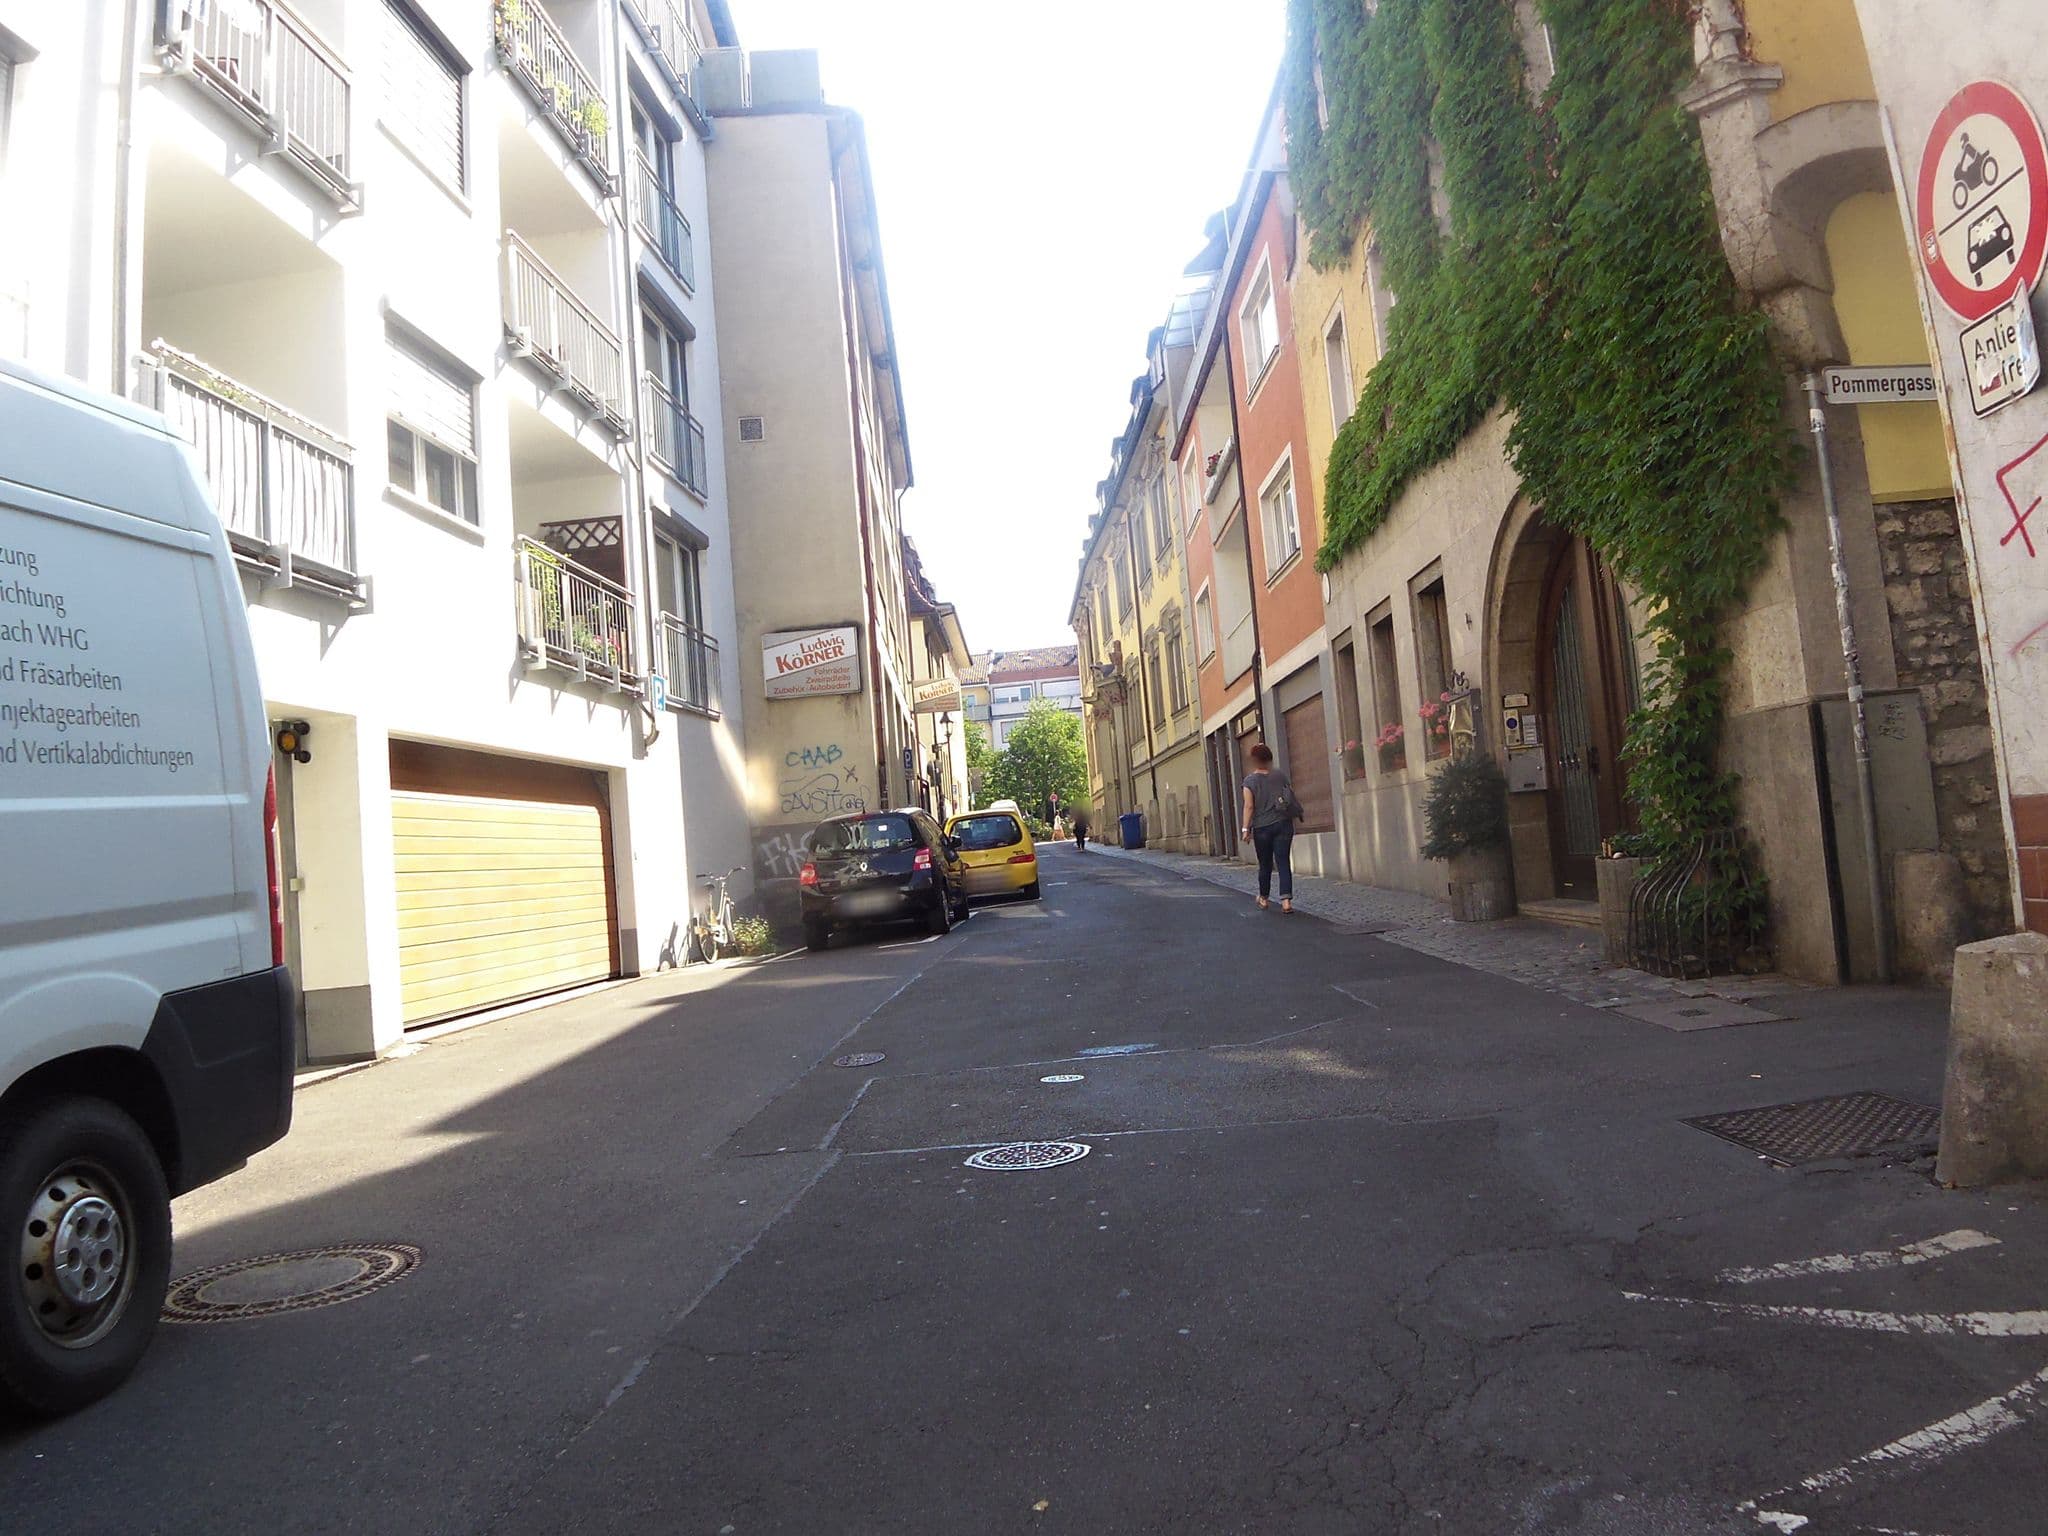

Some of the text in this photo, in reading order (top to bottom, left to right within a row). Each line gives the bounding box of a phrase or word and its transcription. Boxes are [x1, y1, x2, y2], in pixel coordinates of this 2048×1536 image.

[37, 623, 89, 651] WHG
[799, 633, 845, 654] Ludwig
[19, 659, 122, 691] Fräsarbeiten
[22, 739, 194, 773] Vertikalabdichtungen
